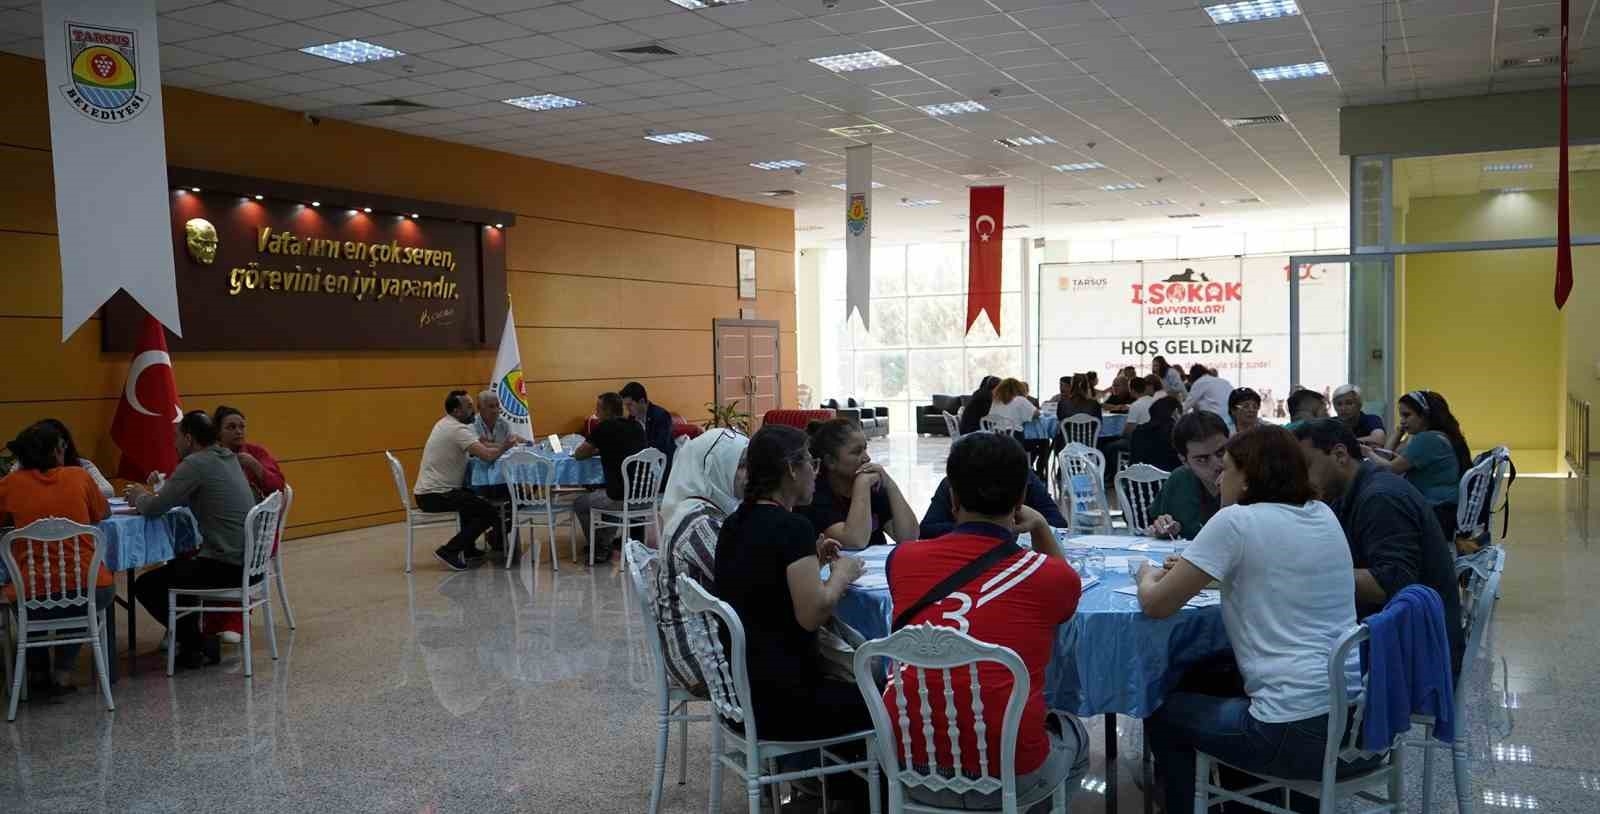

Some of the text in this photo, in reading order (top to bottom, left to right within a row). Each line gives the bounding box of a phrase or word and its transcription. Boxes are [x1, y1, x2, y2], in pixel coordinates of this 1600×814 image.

[344, 239, 366, 261] en
[368, 240, 401, 268] çok
[402, 246, 457, 272] seven,
[229, 261, 322, 296] görevini
[324, 271, 348, 295] en
[353, 269, 377, 300] iyi
[1156, 316, 1217, 328] ÇALIŞTAYI
[1121, 340, 1159, 357] HOŞ
